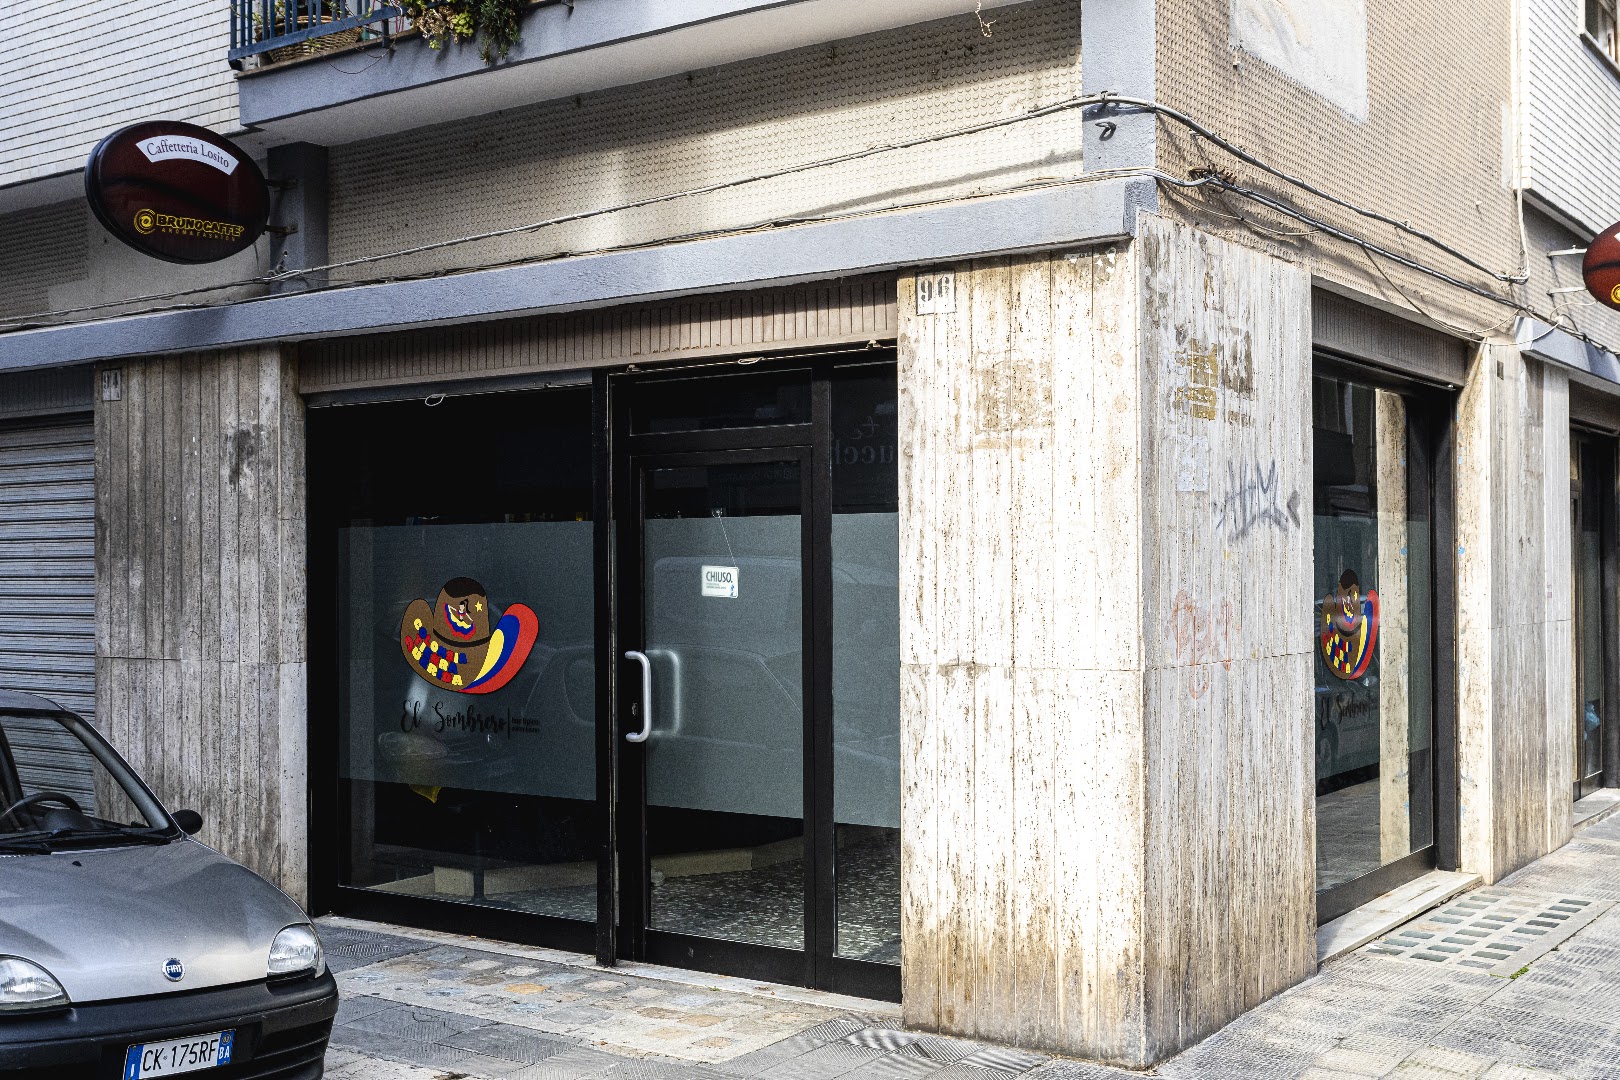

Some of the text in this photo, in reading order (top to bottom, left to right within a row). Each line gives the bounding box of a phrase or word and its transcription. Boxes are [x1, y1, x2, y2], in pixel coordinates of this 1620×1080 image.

[146, 138, 230, 168] Caffetteria Losito
[705, 571, 733, 584] CHIUSO.
[401, 700, 422, 733] El
[432, 701, 507, 734] Sombrero
[166, 964, 182, 974] FIAT
[142, 1047, 165, 1072] CK
[171, 1038, 220, 1068] 175RF
